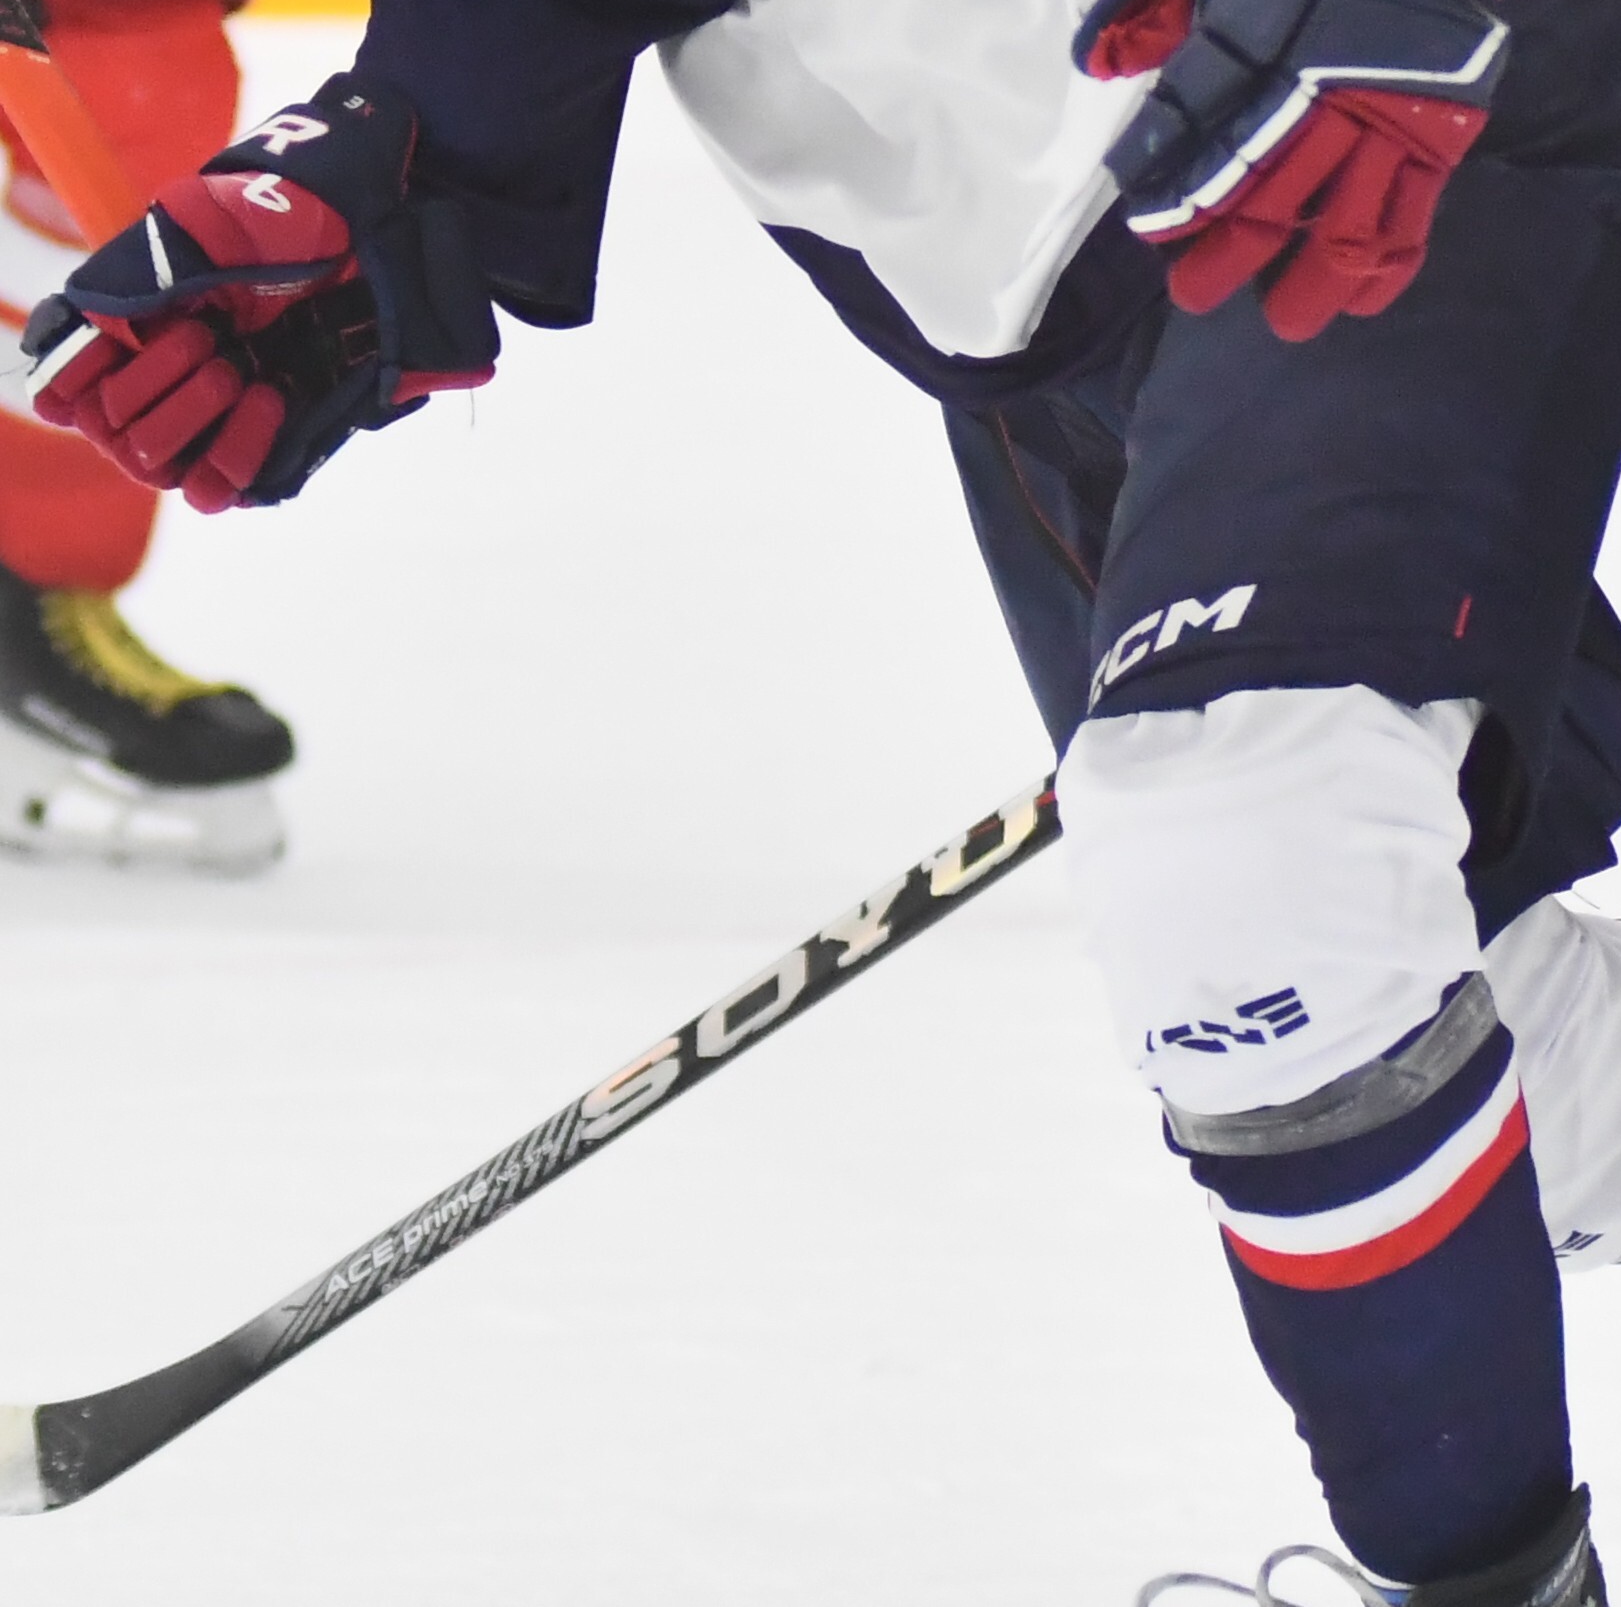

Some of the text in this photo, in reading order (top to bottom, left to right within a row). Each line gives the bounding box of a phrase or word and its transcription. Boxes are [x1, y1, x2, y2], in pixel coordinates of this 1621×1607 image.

[578, 774, 1060, 1141] SOYU
[323, 1239, 395, 1303] ACE
[402, 1179, 489, 1255] prime
